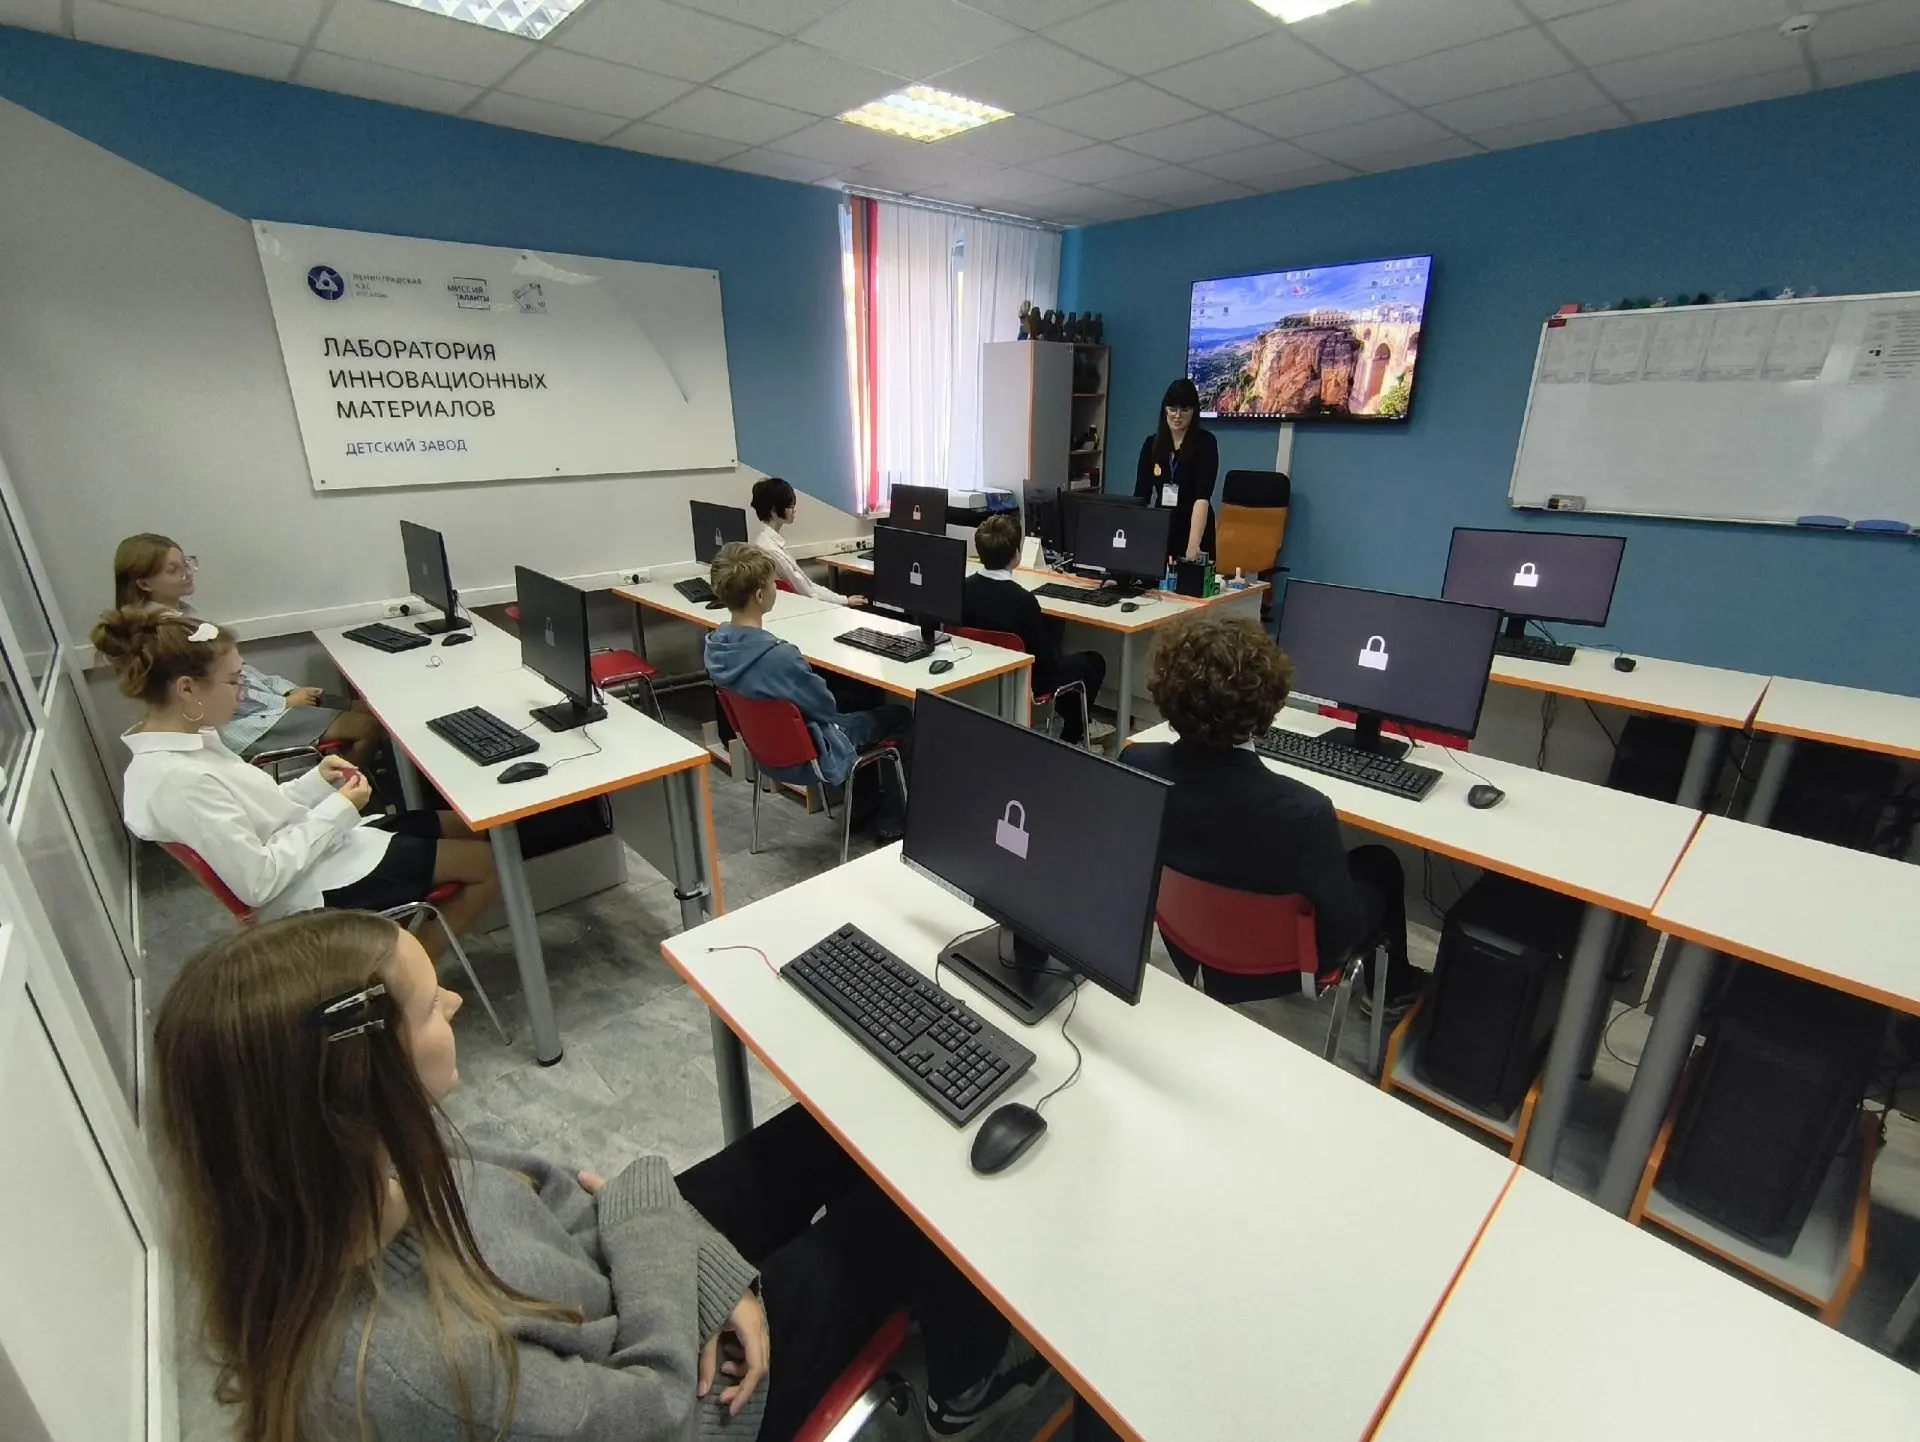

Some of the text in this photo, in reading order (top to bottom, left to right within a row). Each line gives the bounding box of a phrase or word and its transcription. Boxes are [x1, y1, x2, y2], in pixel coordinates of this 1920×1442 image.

[447, 284, 484, 294] МИССИЯ
[323, 337, 497, 362] ЛАБОРАТОРИЯ
[328, 369, 548, 391] ИННОВАЦИОННЫХ
[336, 399, 497, 419] МАТЕРИАЛОВ
[345, 437, 468, 456] ДЕТСКИЙ ЗАВОД
